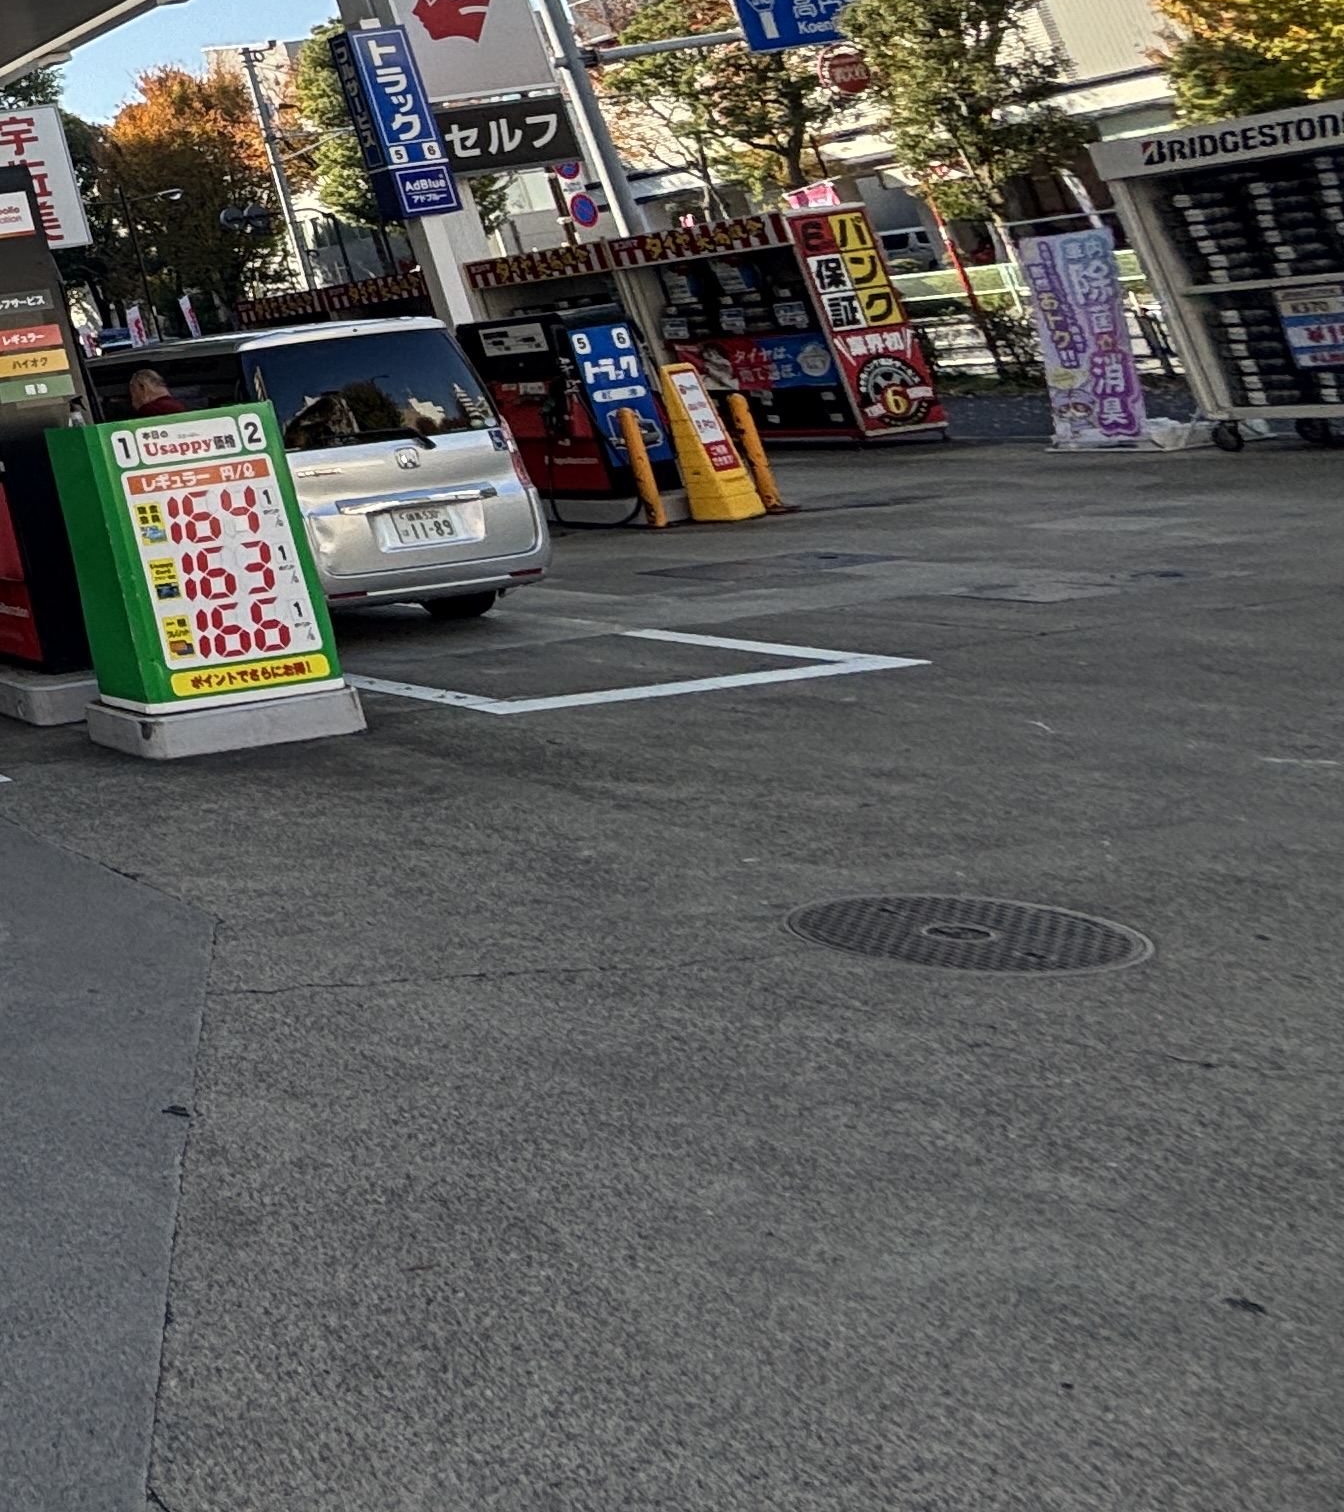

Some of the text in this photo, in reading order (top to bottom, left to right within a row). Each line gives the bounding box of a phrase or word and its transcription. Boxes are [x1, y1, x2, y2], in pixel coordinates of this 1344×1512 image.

[797, 20, 837, 35] Koen
[367, 39, 421, 141] トラック
[444, 114, 558, 158] セルフ
[1143, 113, 1344, 165] BRIDGESTON
[395, 144, 436, 161] 5 6
[405, 177, 446, 192] AdBlue
[413, 193, 448, 204] アドブルー
[838, 215, 893, 323] パンク
[814, 257, 863, 327] 保証
[2, 332, 45, 345] レギュラー
[577, 332, 627, 351] 5 6
[13, 357, 48, 369] ハイオク
[584, 355, 639, 384] トラック
[142, 430, 168, 440] 本日の
[243, 422, 262, 444] 2
[117, 437, 131, 459] 1
[142, 471, 211, 491] レギュラー
[167, 485, 272, 545] 164 1
[411, 519, 454, 540] 11-89
[181, 540, 287, 601] 163 1
[196, 596, 303, 659] 166 1
